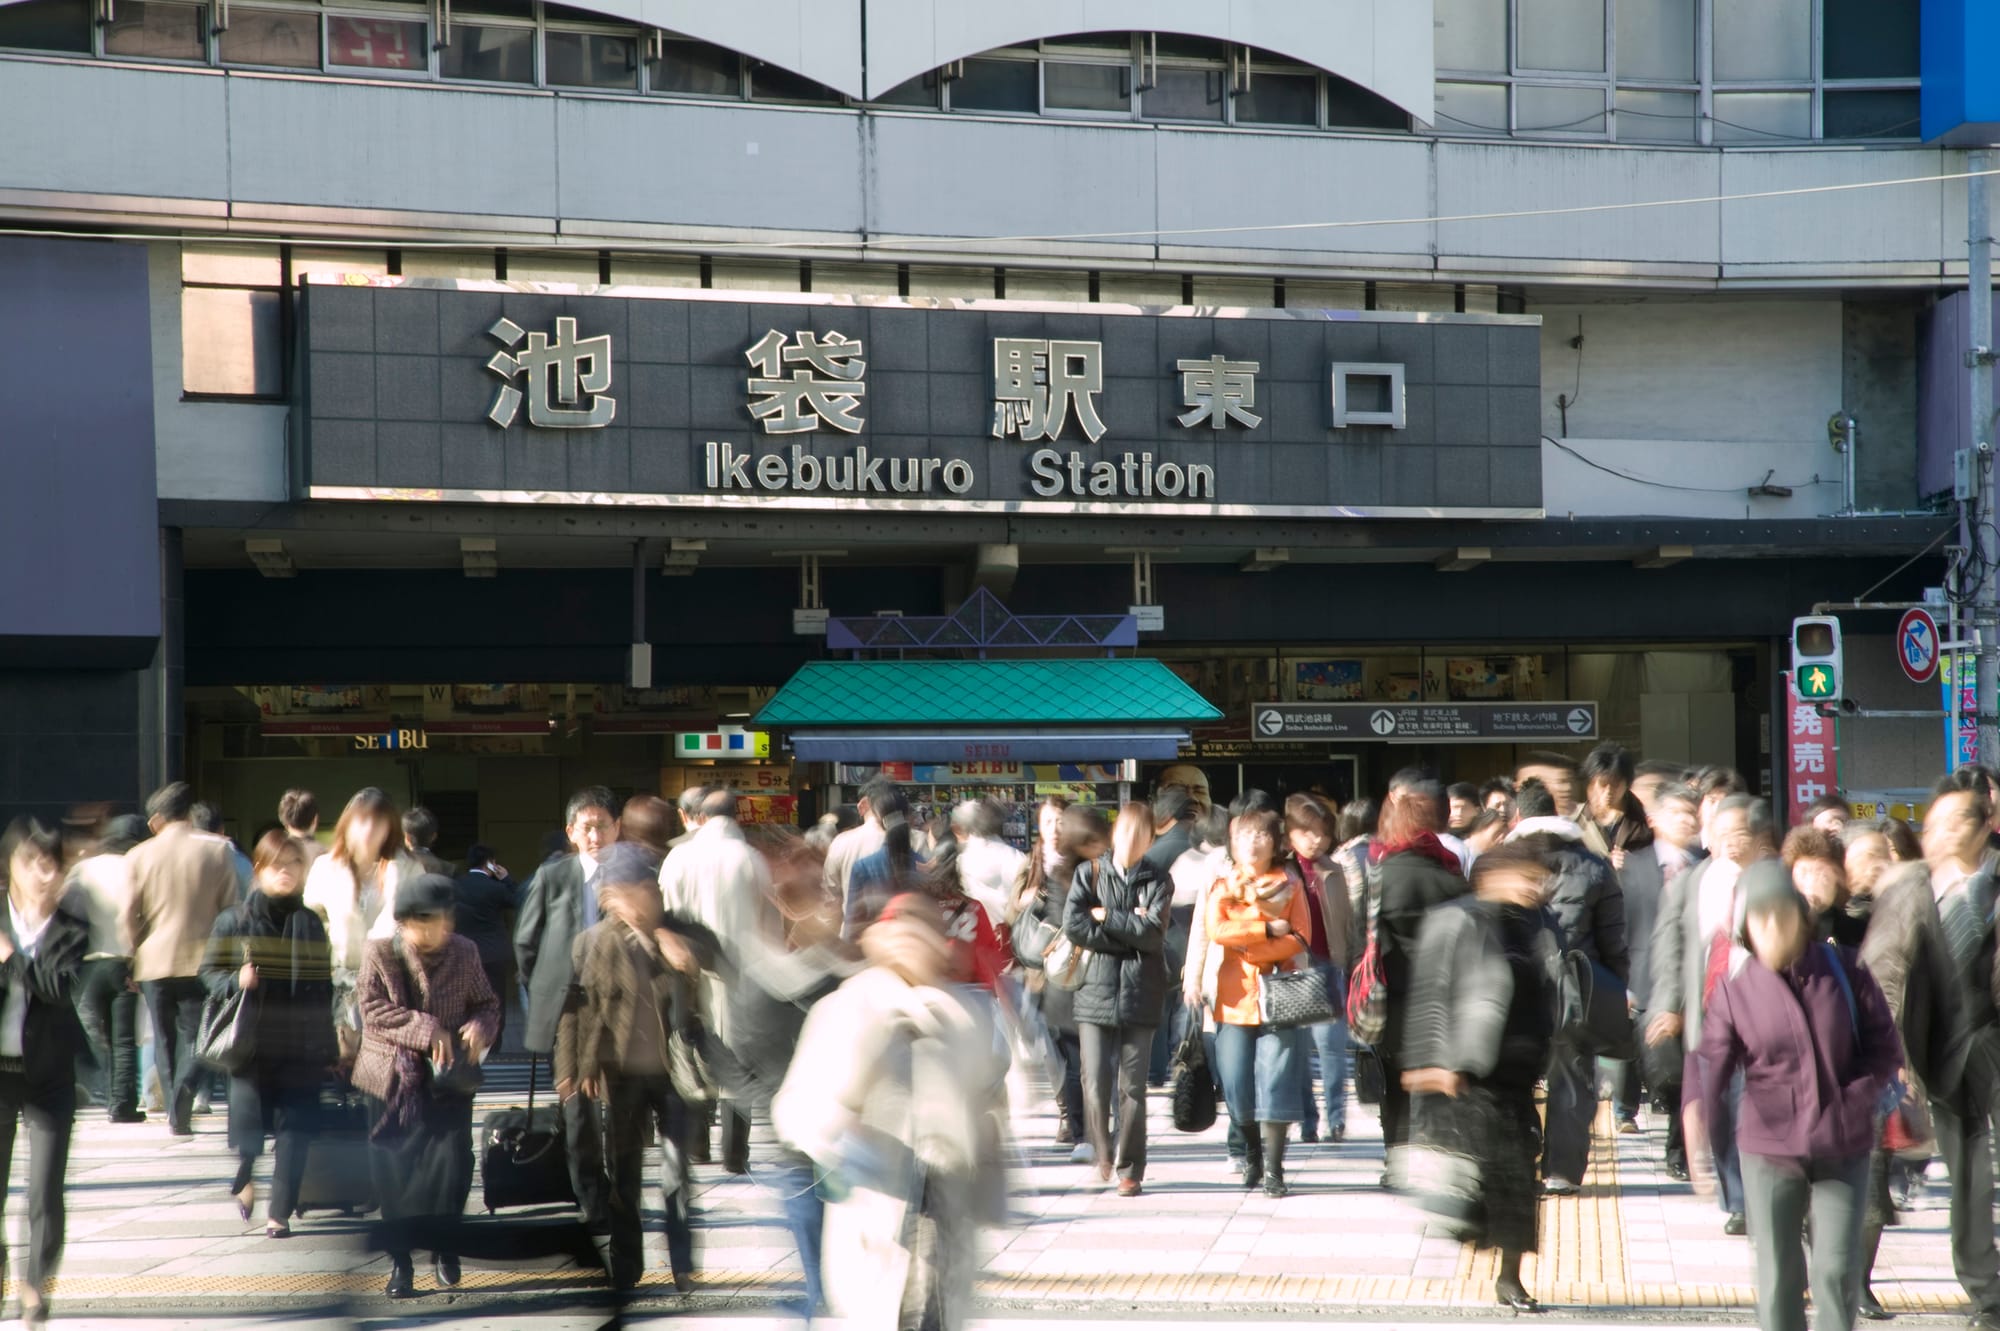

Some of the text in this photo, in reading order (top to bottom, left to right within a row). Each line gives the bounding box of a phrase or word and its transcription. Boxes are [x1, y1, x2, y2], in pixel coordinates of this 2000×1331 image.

[487, 316, 1407, 443] 池袋駅東口
[705, 441, 1216, 499] Ikebukuro Station
[1285, 713, 1333, 723] 西武池袋線
[1493, 712, 1558, 722] 地下鉄丸ノ内線
[355, 729, 428, 749] SEIBU
[964, 744, 1009, 757] SEIBU
[952, 761, 1018, 774] SEIBU
